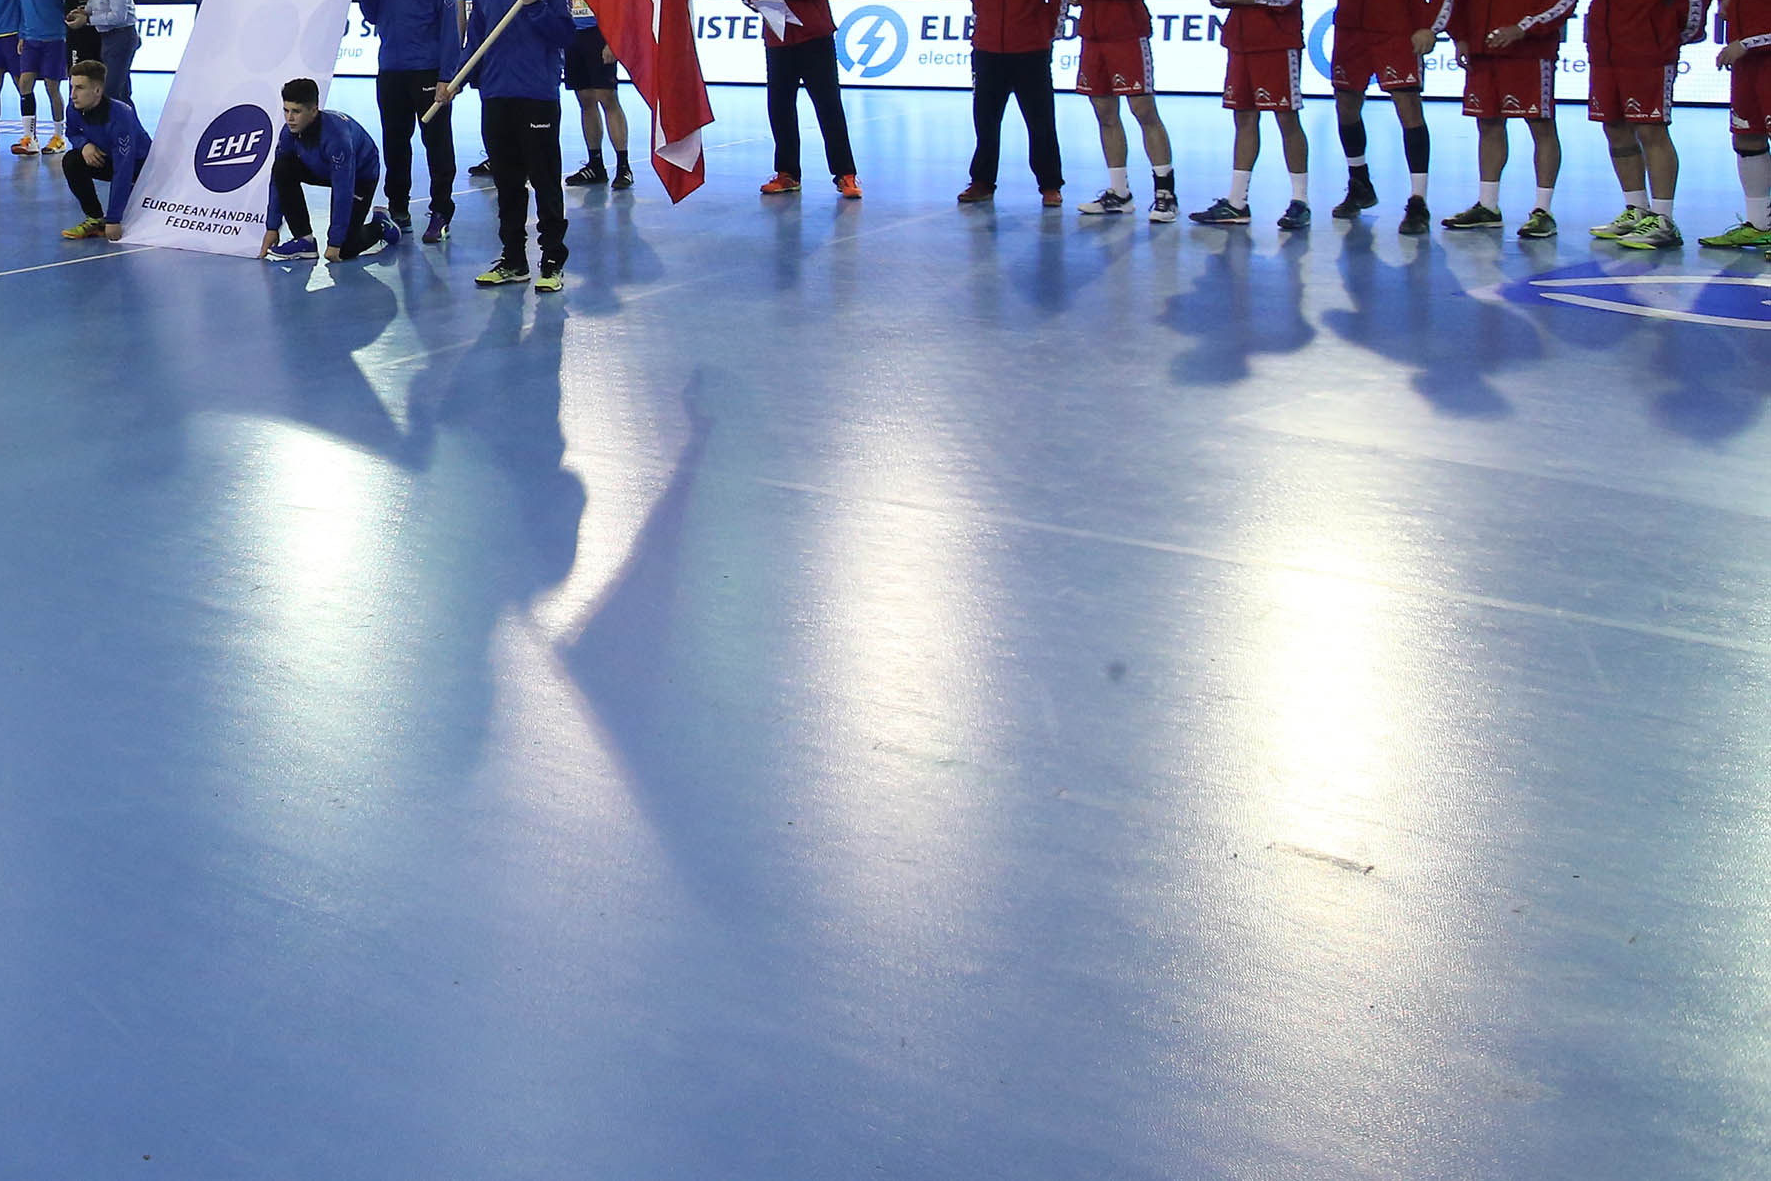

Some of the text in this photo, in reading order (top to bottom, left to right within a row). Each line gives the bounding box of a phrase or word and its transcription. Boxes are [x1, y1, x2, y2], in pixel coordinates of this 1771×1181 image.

[206, 130, 264, 159] EHF
[141, 197, 266, 224] EUROPEAN HANDBAL
[165, 216, 242, 236] FEDERATION
